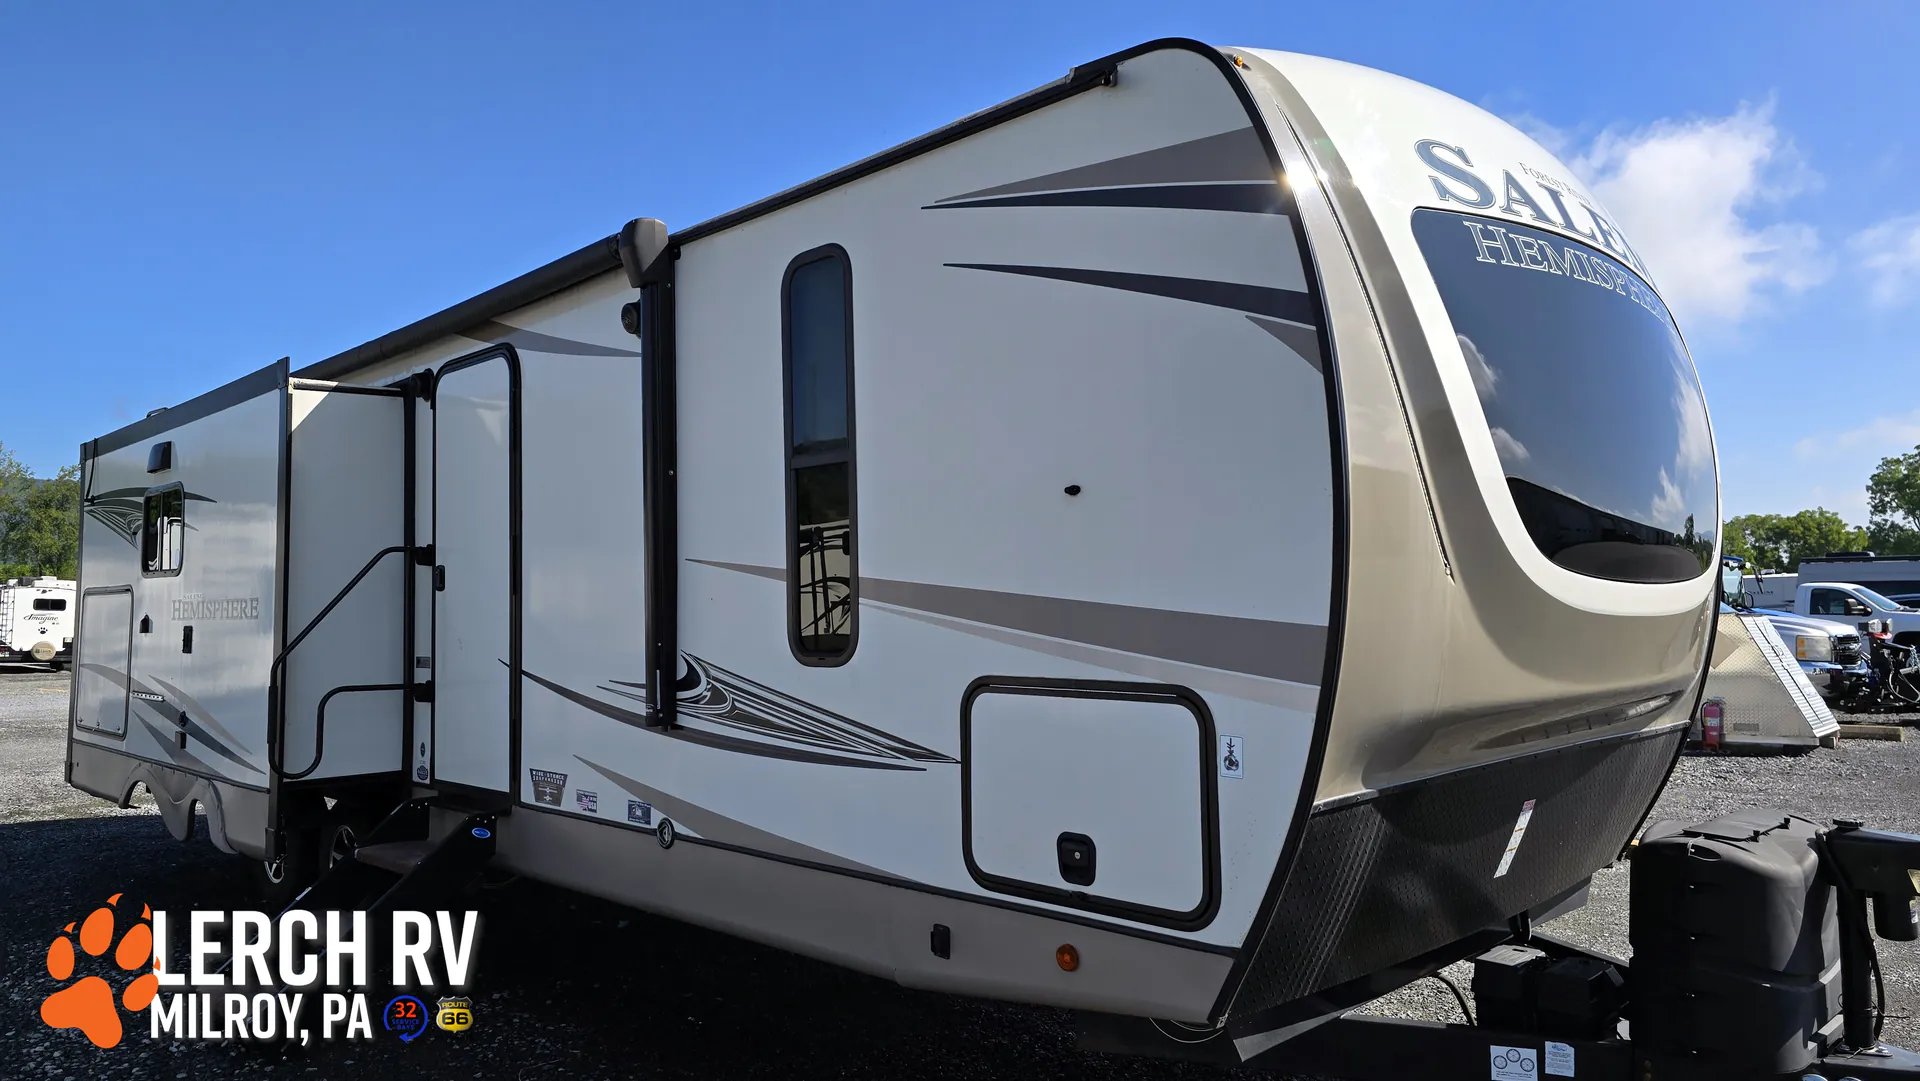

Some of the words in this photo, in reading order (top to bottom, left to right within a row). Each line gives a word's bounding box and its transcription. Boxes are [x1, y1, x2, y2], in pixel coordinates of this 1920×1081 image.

[1518, 161, 1565, 191] FOREST
[24, 613, 58, 625] Imagine
[171, 597, 260, 621] HEMISPHERE
